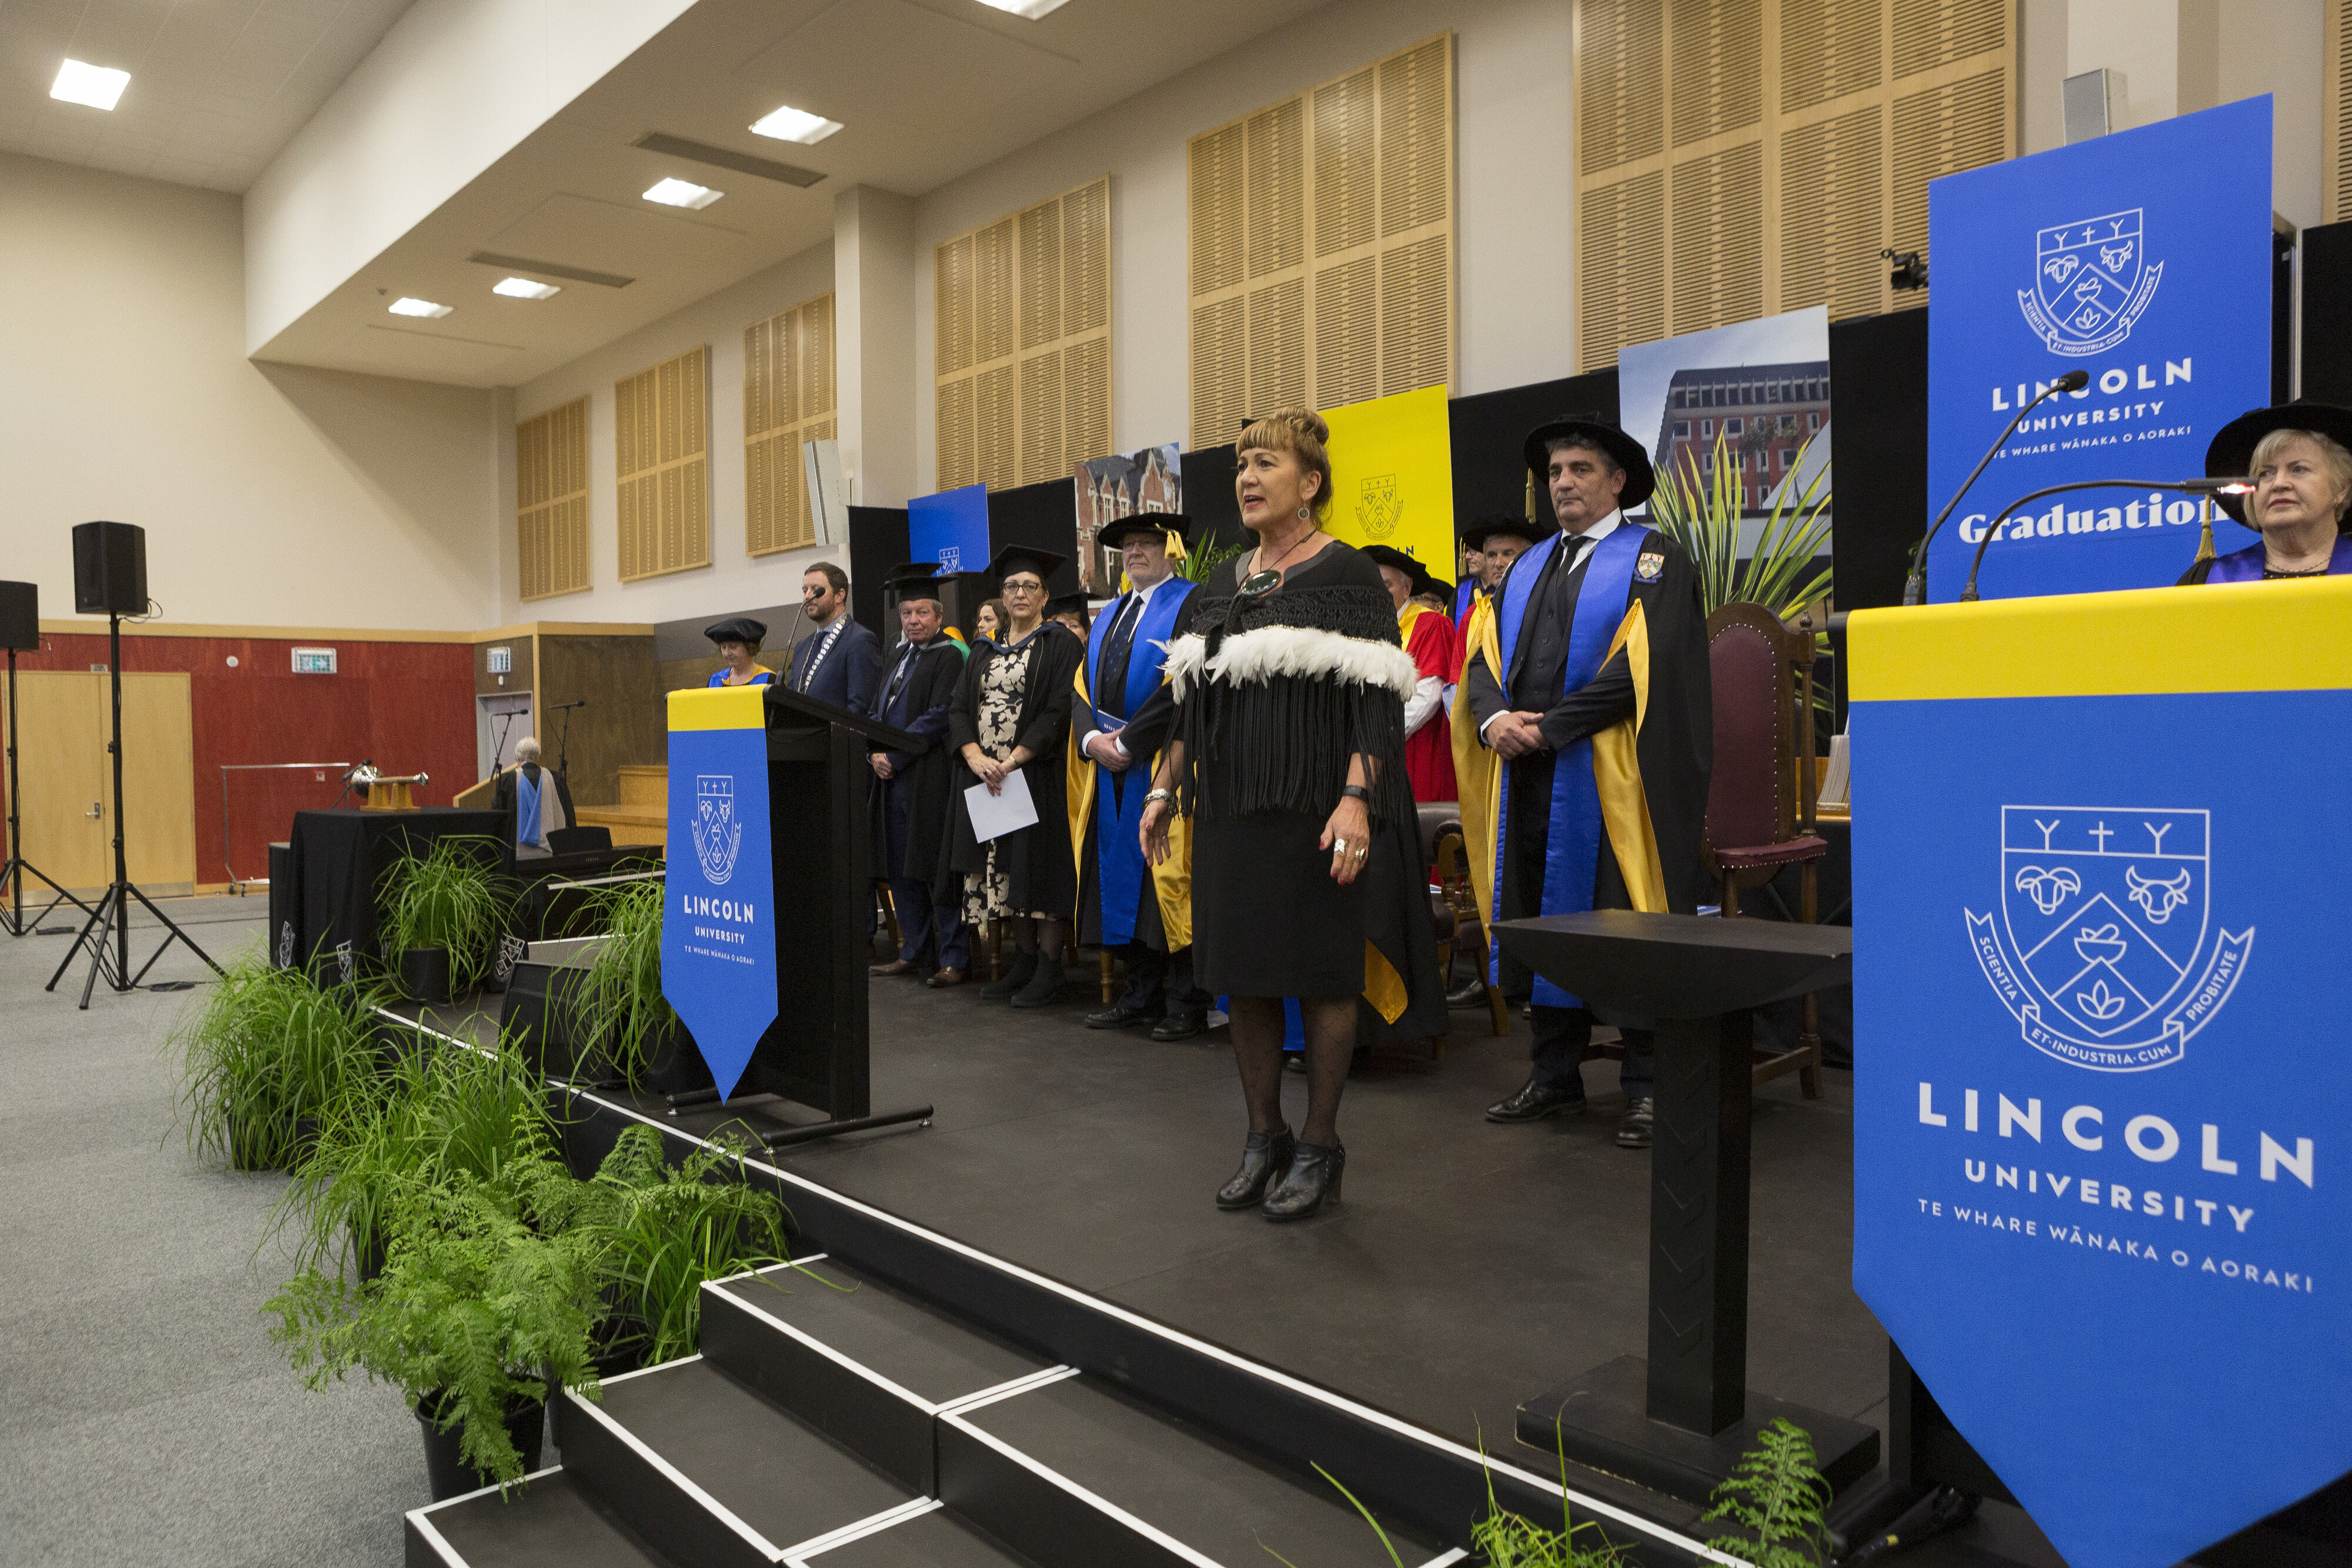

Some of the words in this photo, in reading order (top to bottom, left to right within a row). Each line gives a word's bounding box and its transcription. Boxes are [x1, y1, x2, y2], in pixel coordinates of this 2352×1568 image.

[2017, 401, 2164, 434] UNIVERSITY
[2011, 442, 2057, 457] WHARE
[2122, 432, 2133, 442] O
[2137, 425, 2192, 441] AORAKI
[1959, 492, 2230, 543] Graduation
[684, 895, 753, 924] LINCOLN
[693, 946, 709, 956] WHARE
[736, 955, 755, 965] AORAKI
[695, 925, 745, 945] UNIVERSITY
[1979, 936, 2018, 1000] SCIENTIA
[2185, 950, 2238, 1021] PROBITATE
[1919, 1081, 2314, 1189] LINCOLN
[1964, 1158, 2254, 1233] UNIVERSITY
[1918, 1198, 1942, 1217] TE
[1953, 1206, 2037, 1236] WHARE
[2049, 1225, 2159, 1262] WĀNAKA
[2171, 1250, 2189, 1266] O
[2201, 1257, 2313, 1293] AORAKI
